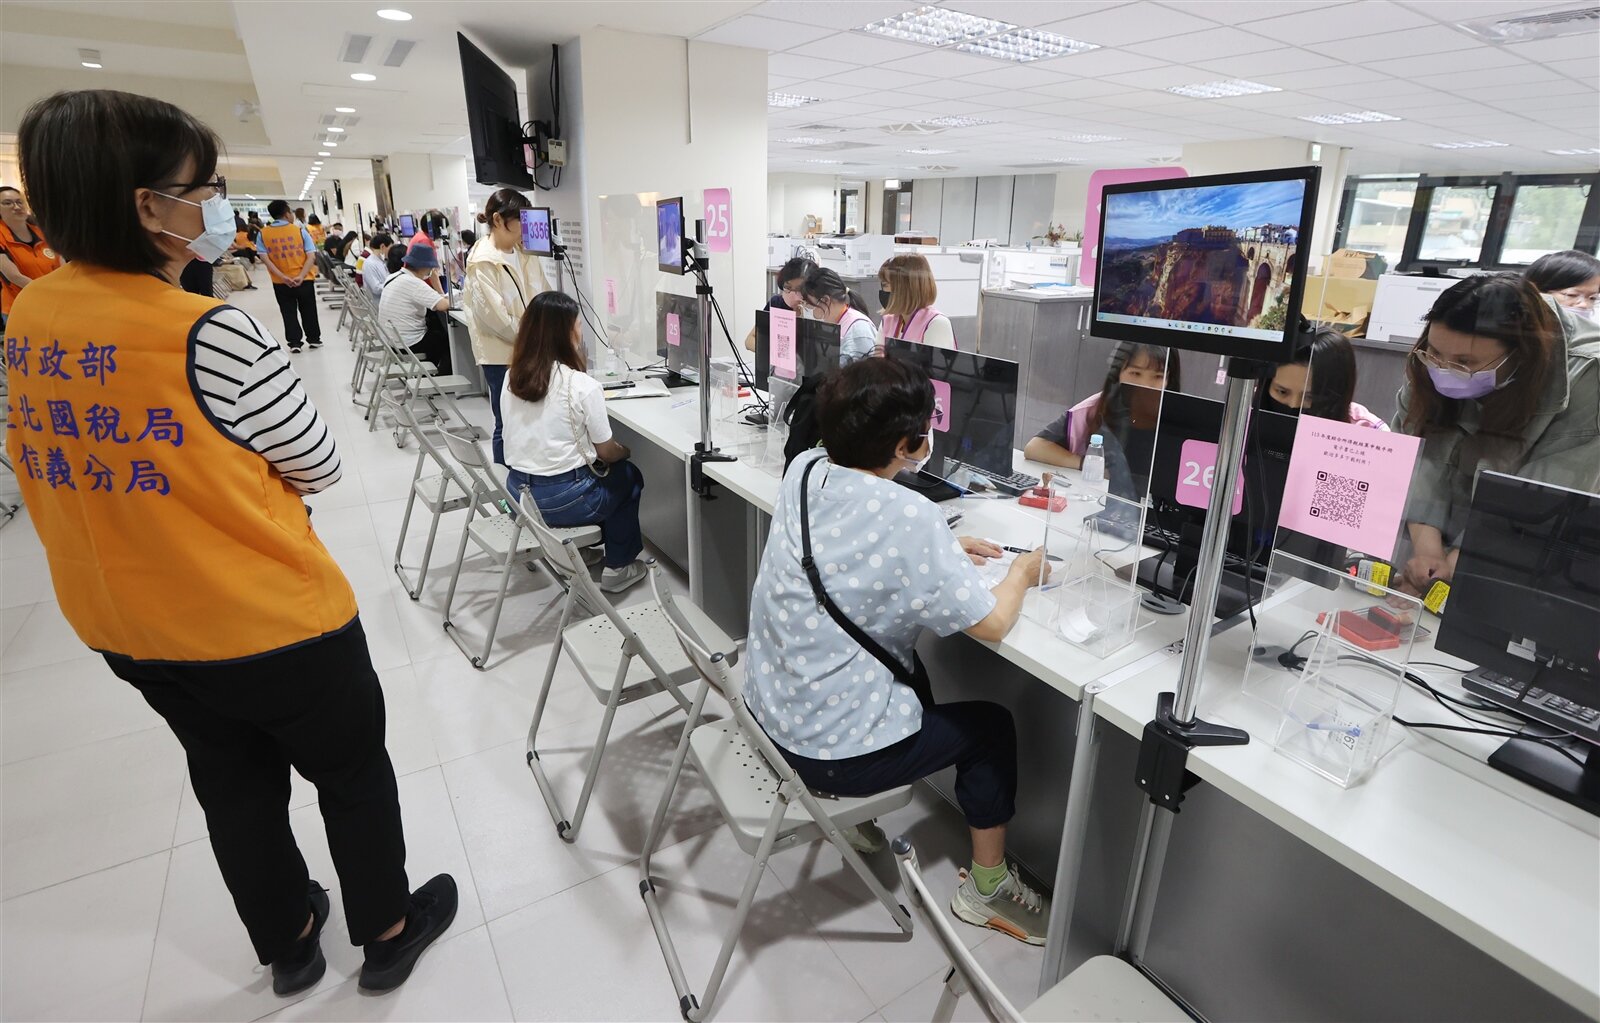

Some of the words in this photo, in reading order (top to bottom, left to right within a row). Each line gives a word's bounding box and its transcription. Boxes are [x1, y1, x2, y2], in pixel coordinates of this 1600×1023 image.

[529, 221, 549, 241] 3356
[707, 203, 728, 237] 25
[669, 323, 678, 336] 25
[6, 336, 117, 386] 財政部
[20, 444, 171, 496] 信義分局
